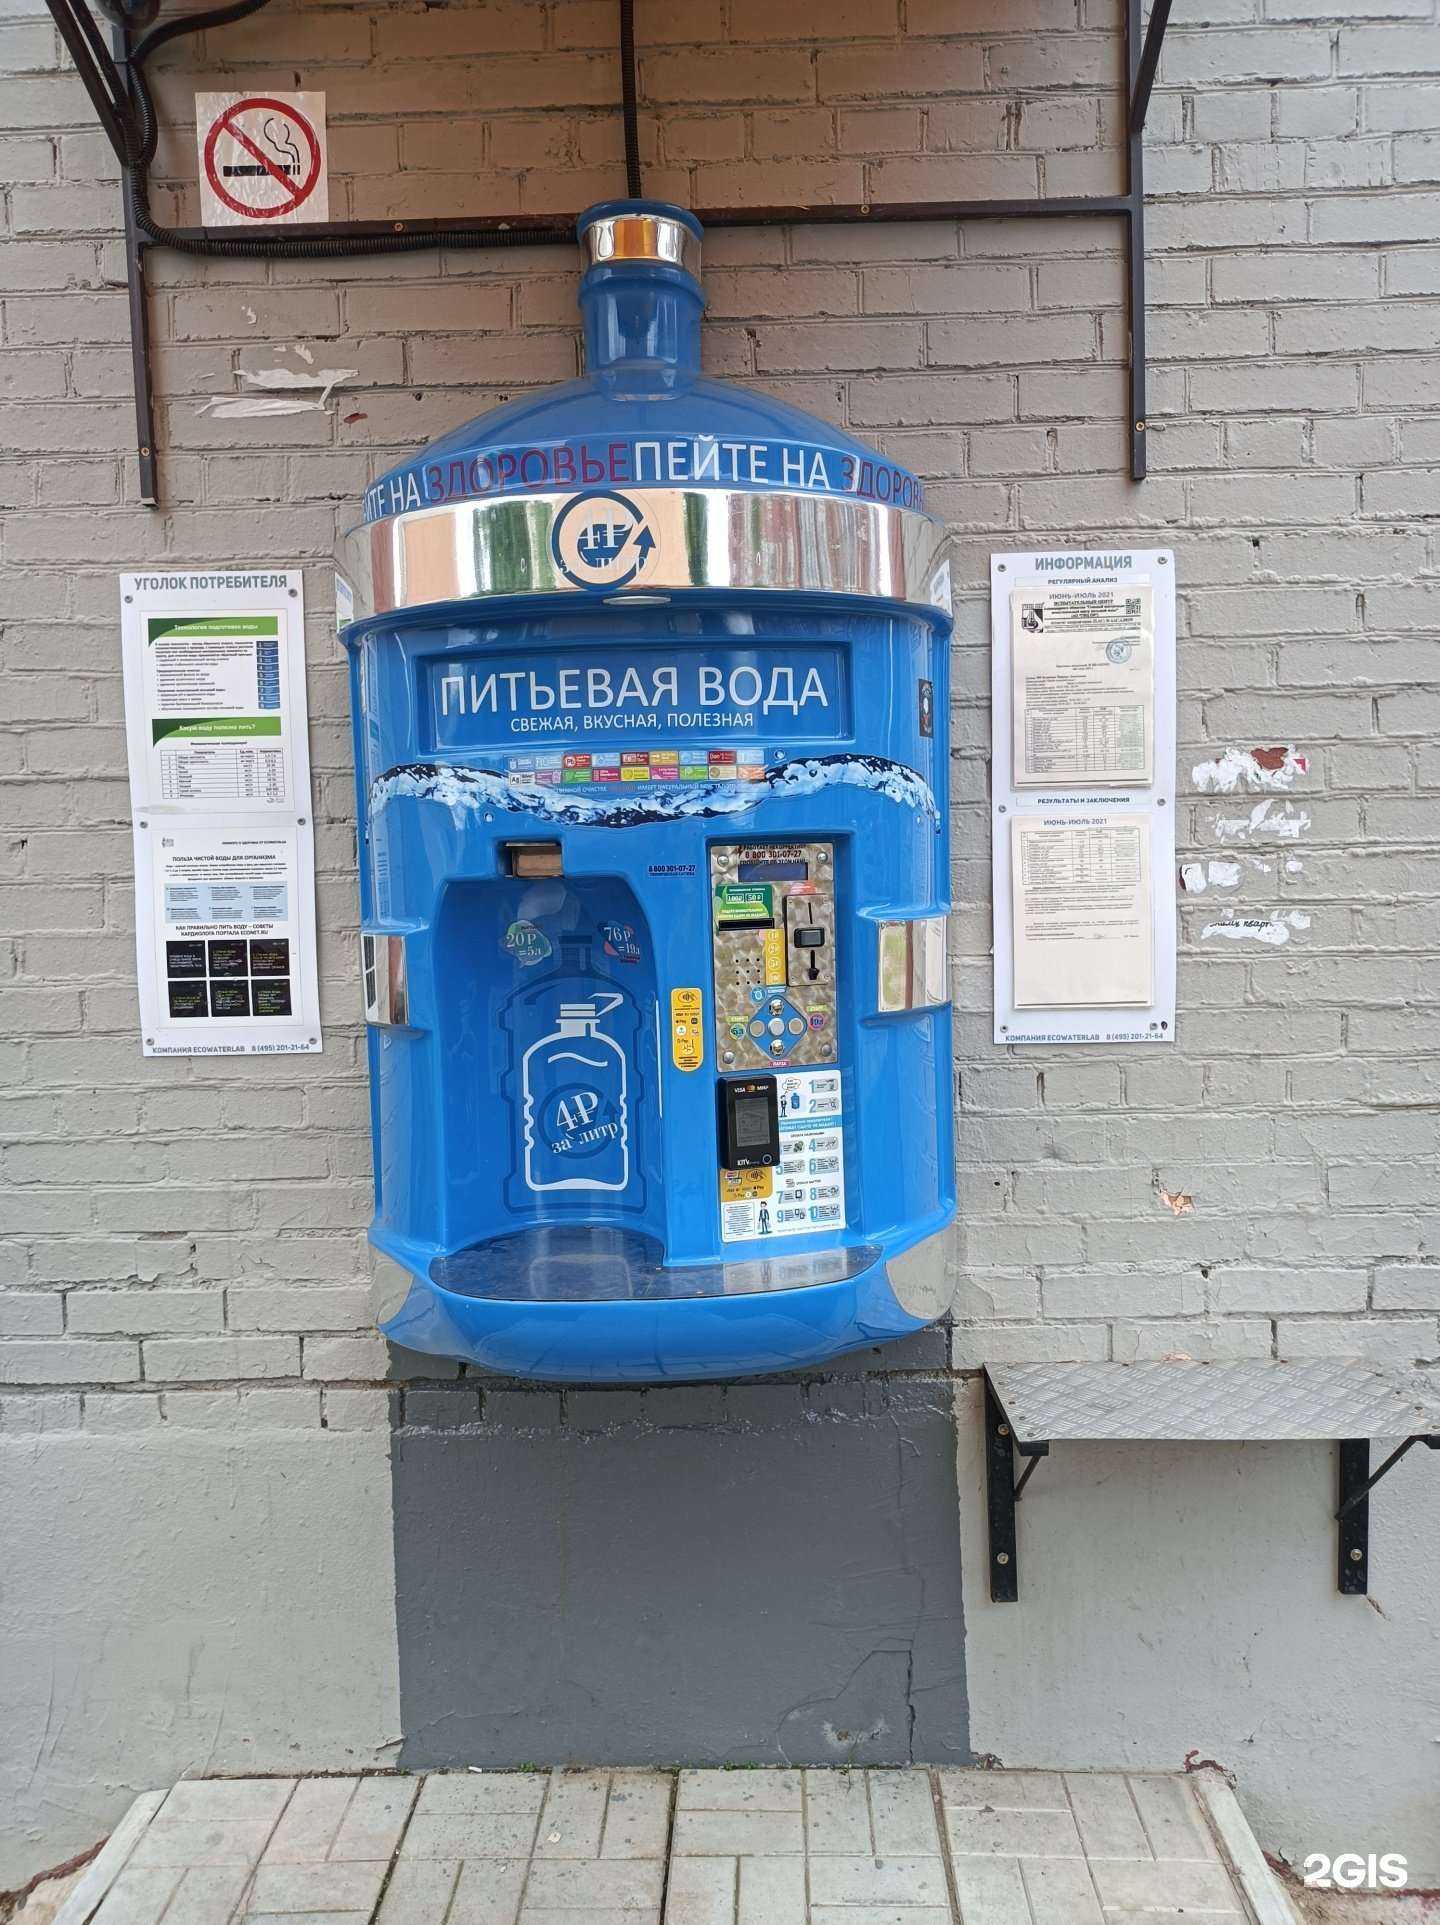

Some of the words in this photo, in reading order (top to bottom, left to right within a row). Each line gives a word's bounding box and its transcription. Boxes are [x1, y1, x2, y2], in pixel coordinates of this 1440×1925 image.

[389, 472, 421, 513] НА
[426, 440, 629, 505] ЗДОРОВЬЕ
[635, 434, 769, 484] ПЕЙТЕ
[783, 447, 831, 491] НА
[1035, 555, 1132, 570] ИНФОРМАЦИЯ
[134, 577, 188, 591] УГОЛОК
[190, 574, 288, 589] ПОТРЕБИТЕЛЯ
[1048, 577, 1091, 585] РЕГУЛЯРНЫЙ
[440, 666, 679, 716] ПИТЬЕВАЯ
[698, 666, 829, 716] ВОДА
[510, 716, 578, 732] СВЕЖАЯ,
[584, 714, 662, 731] ВКУСНАЯ,
[667, 713, 753, 728] ПОЛЕЗНАЯ
[752, 851, 766, 859] 800
[768, 850, 802, 858] 301-07-27
[666, 864, 696, 872] 301-07-27
[506, 931, 525, 948] 20
[603, 927, 622, 941] 76
[1111, 1033, 1130, 1041] (495)
[808, 1080, 815, 1093] 1
[809, 1099, 817, 1113] 2
[551, 1138, 572, 1154] за
[579, 1122, 618, 1145] литр
[808, 1138, 817, 1152] 4
[809, 1158, 817, 1175] 6
[776, 1191, 784, 1205] 7
[809, 1187, 817, 1200] 8
[776, 1210, 784, 1223] 9
[808, 1205, 818, 1222] 10
